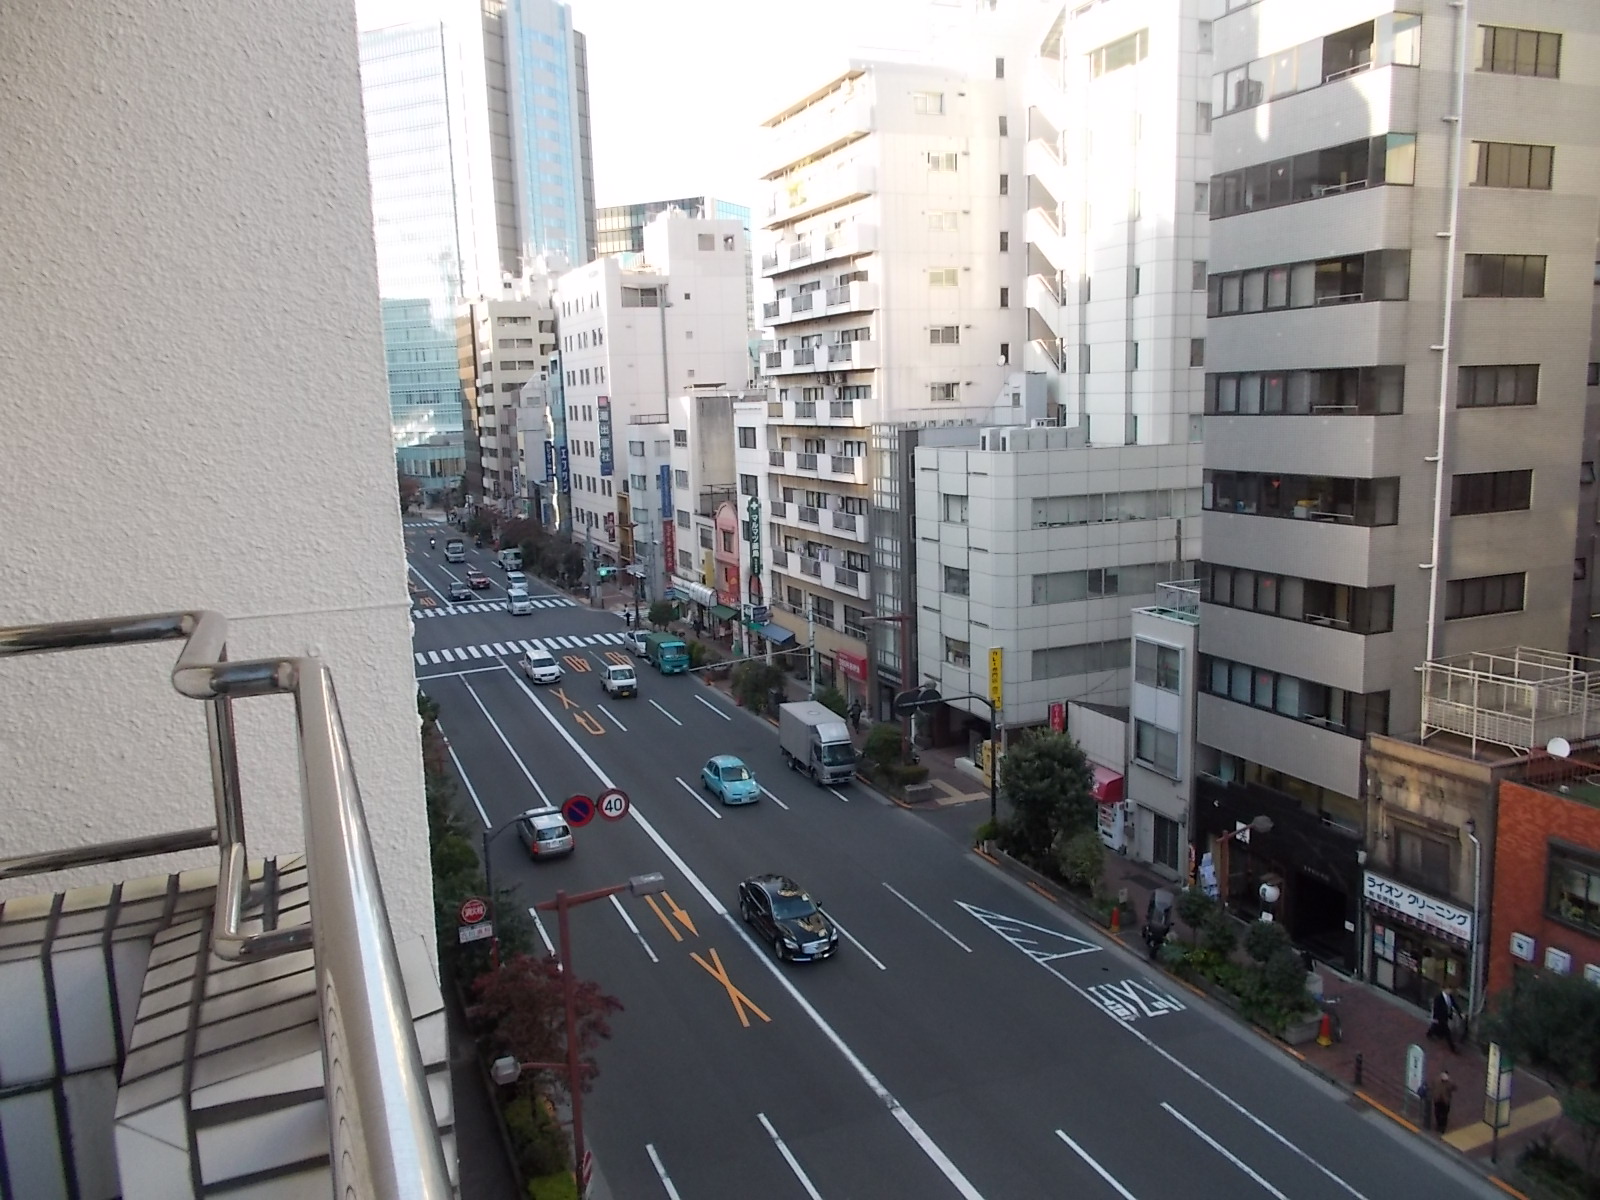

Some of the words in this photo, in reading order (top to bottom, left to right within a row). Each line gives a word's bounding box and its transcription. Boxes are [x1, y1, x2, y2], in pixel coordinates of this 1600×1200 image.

[604, 798, 622, 813] 40
[1366, 876, 1404, 899] ライオン
[1407, 893, 1468, 926] クリーニング
